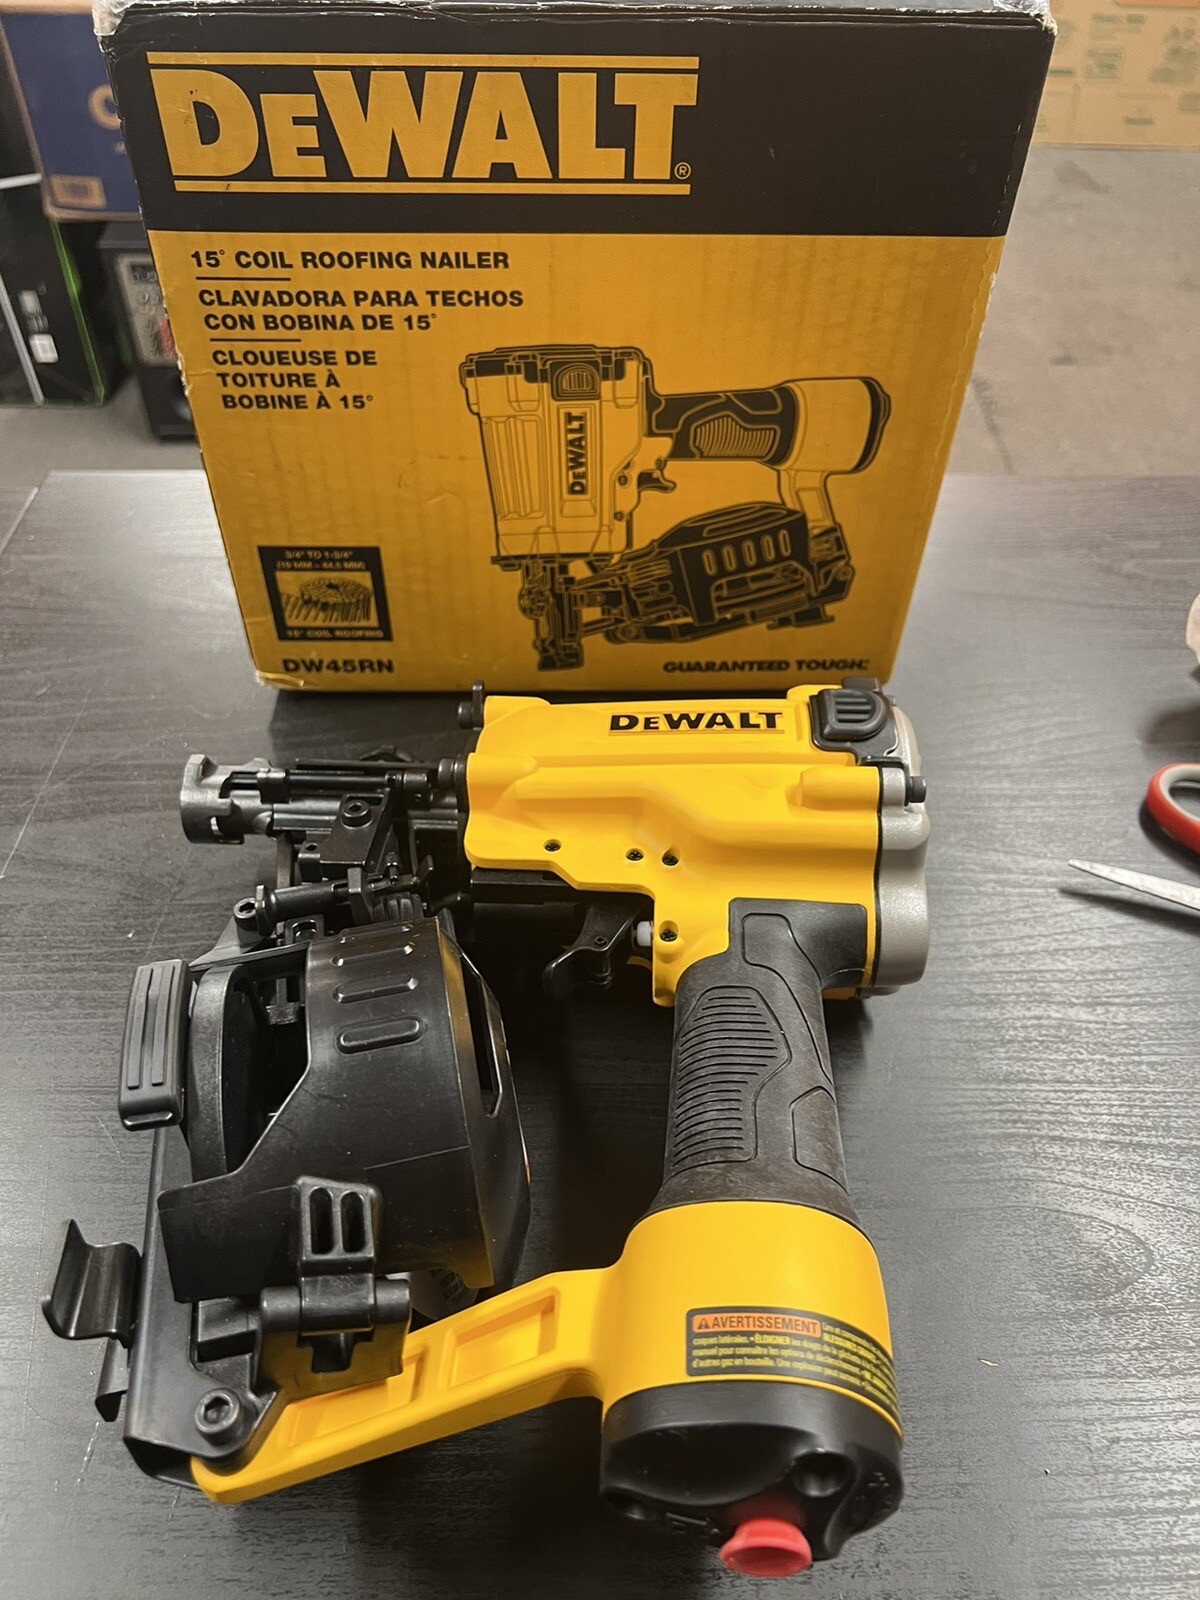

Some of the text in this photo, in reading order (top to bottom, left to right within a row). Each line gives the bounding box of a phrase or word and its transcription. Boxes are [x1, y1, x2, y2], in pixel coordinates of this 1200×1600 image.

[235, 251, 293, 269] COIL
[301, 251, 412, 269] ROOFING
[421, 252, 509, 269] NAILER
[199, 289, 523, 307] CLAVADORA PARA TECHOS
[204, 313, 255, 331] CON
[263, 314, 355, 331] BOBINA
[362, 314, 394, 331] DE
[212, 350, 377, 366] CLOUEUSE DE
[217, 369, 340, 388] TOITURE À
[222, 394, 308, 410] BOBINE
[317, 391, 331, 410] À
[565, 412, 587, 495] DEWALT
[283, 659, 394, 672] DW45RN
[664, 660, 790, 672] GUARANTEED
[610, 712, 782, 731] DEWALT
[712, 1316, 818, 1334] AVERTISSEMENT
